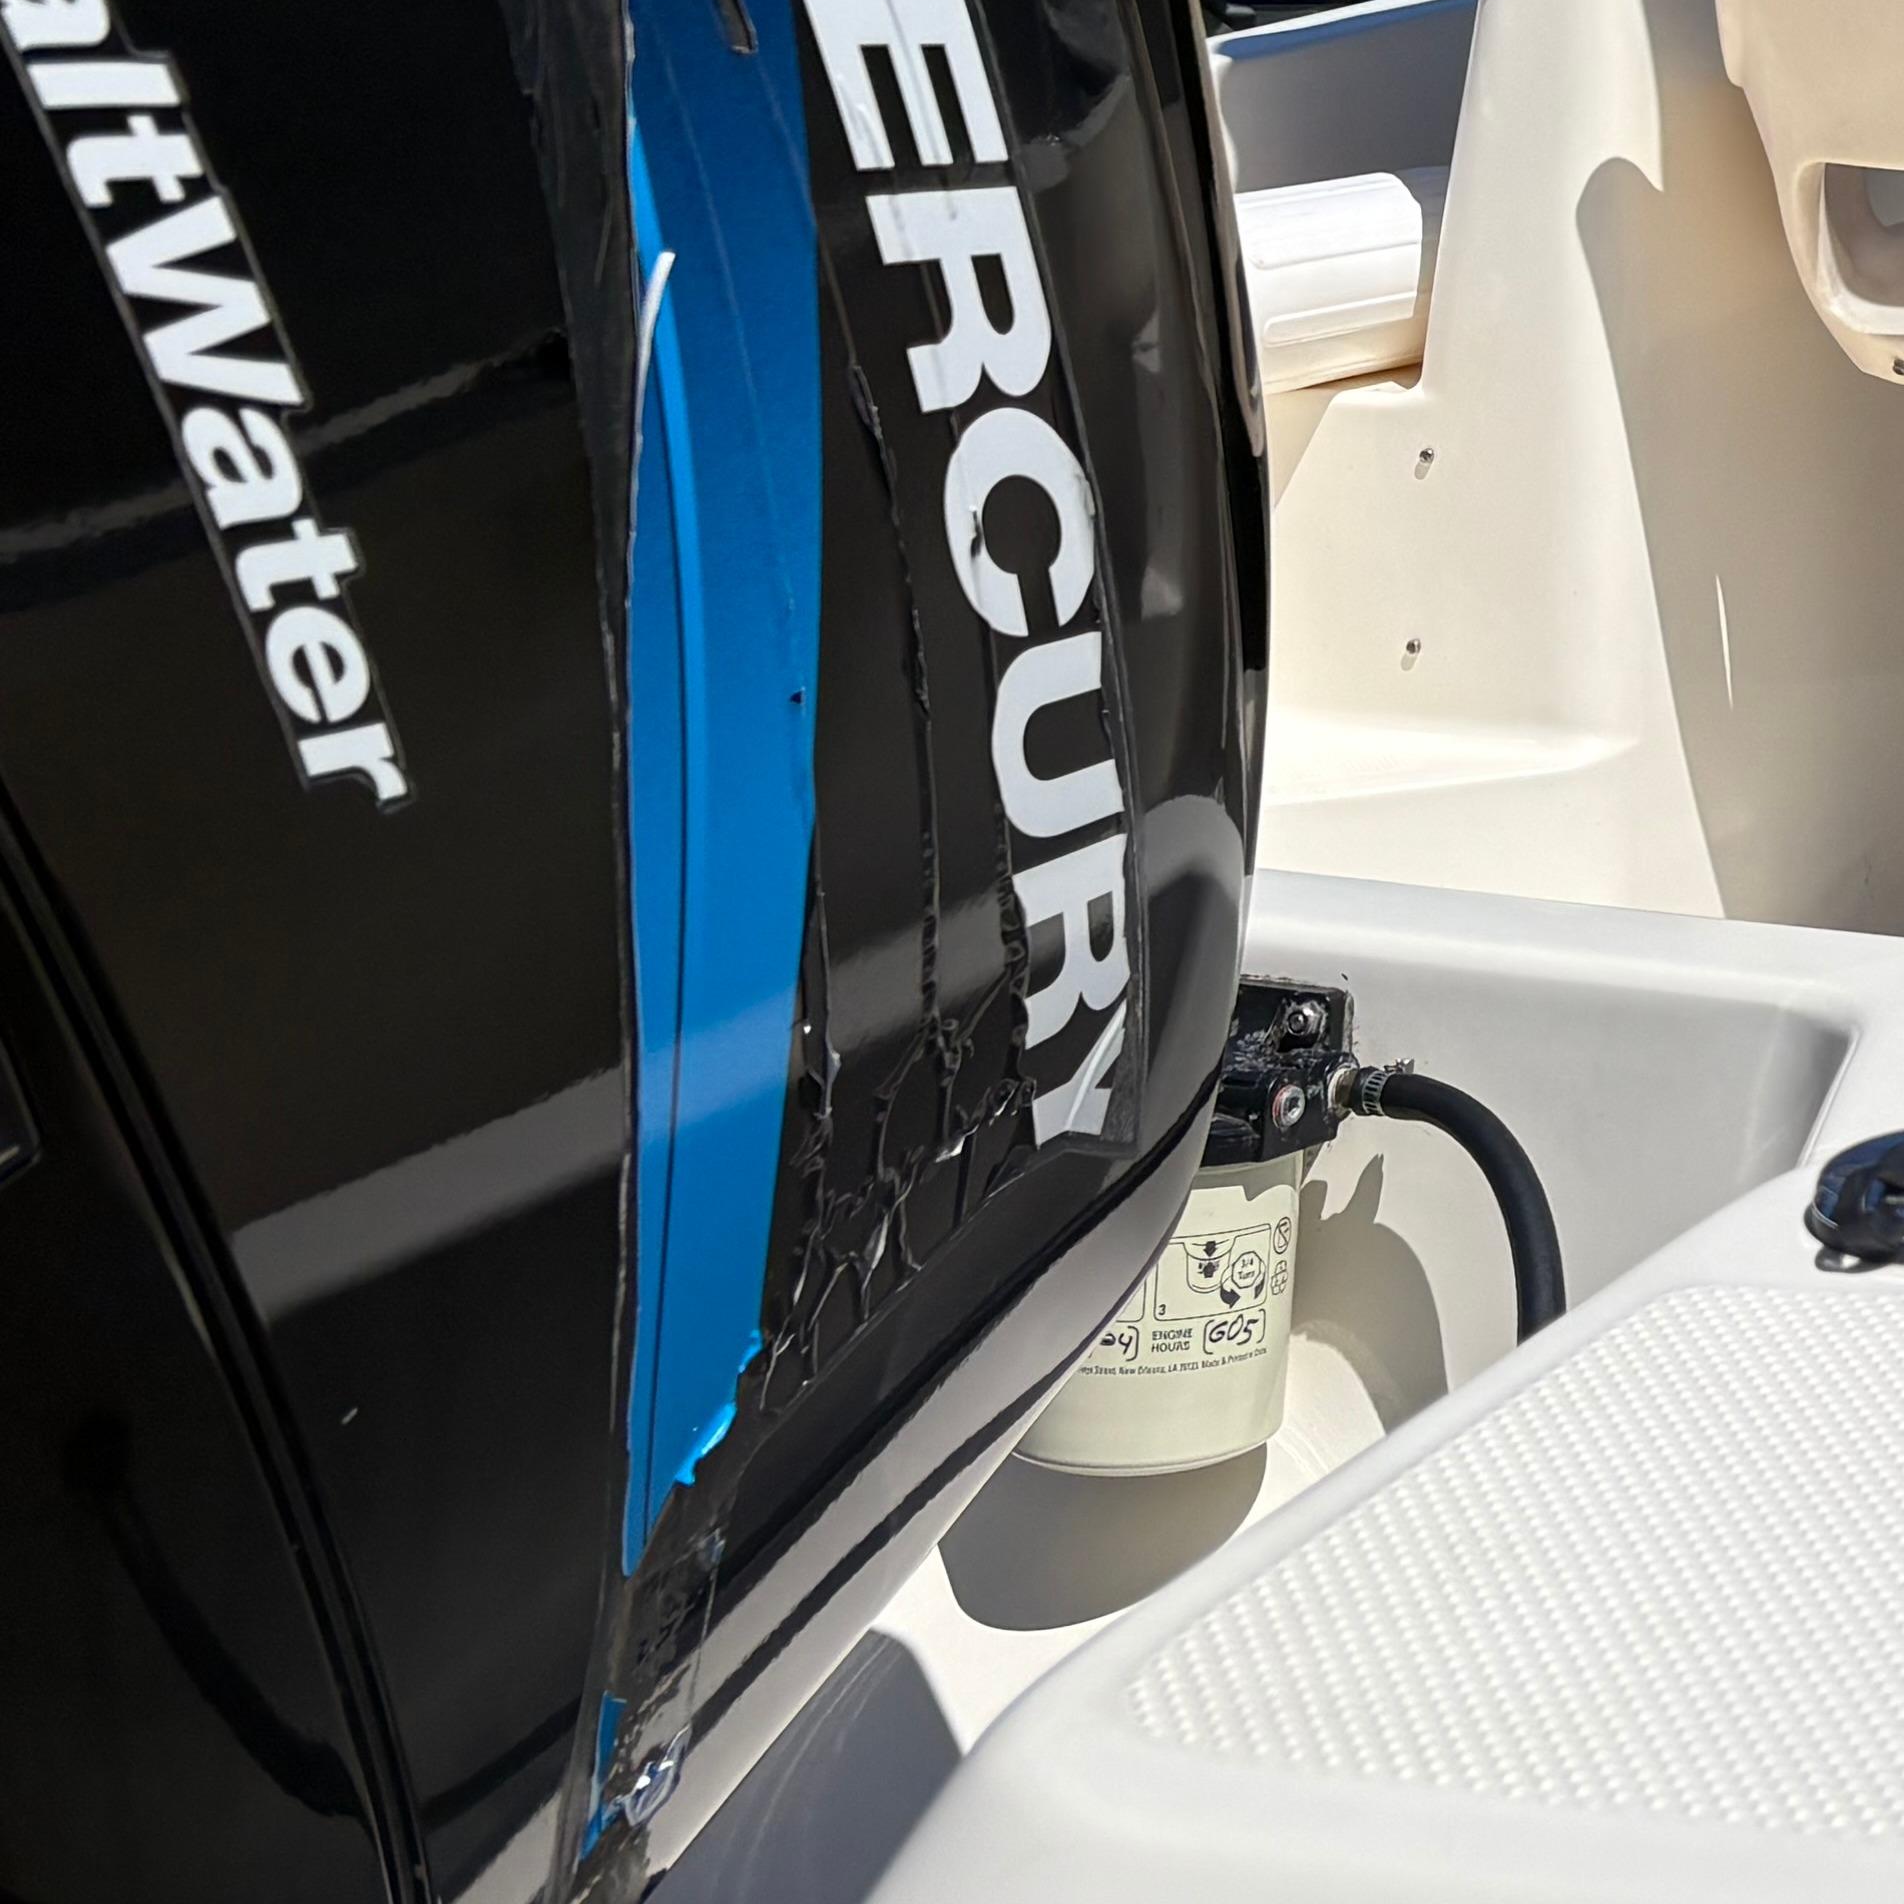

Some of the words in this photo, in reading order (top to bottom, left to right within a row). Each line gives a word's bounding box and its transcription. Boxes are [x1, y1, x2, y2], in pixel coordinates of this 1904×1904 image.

[1157, 1303, 1167, 1316] 3
[1151, 1327, 1193, 1341] ENGINE
[1151, 1340, 1191, 1353] HOURS
